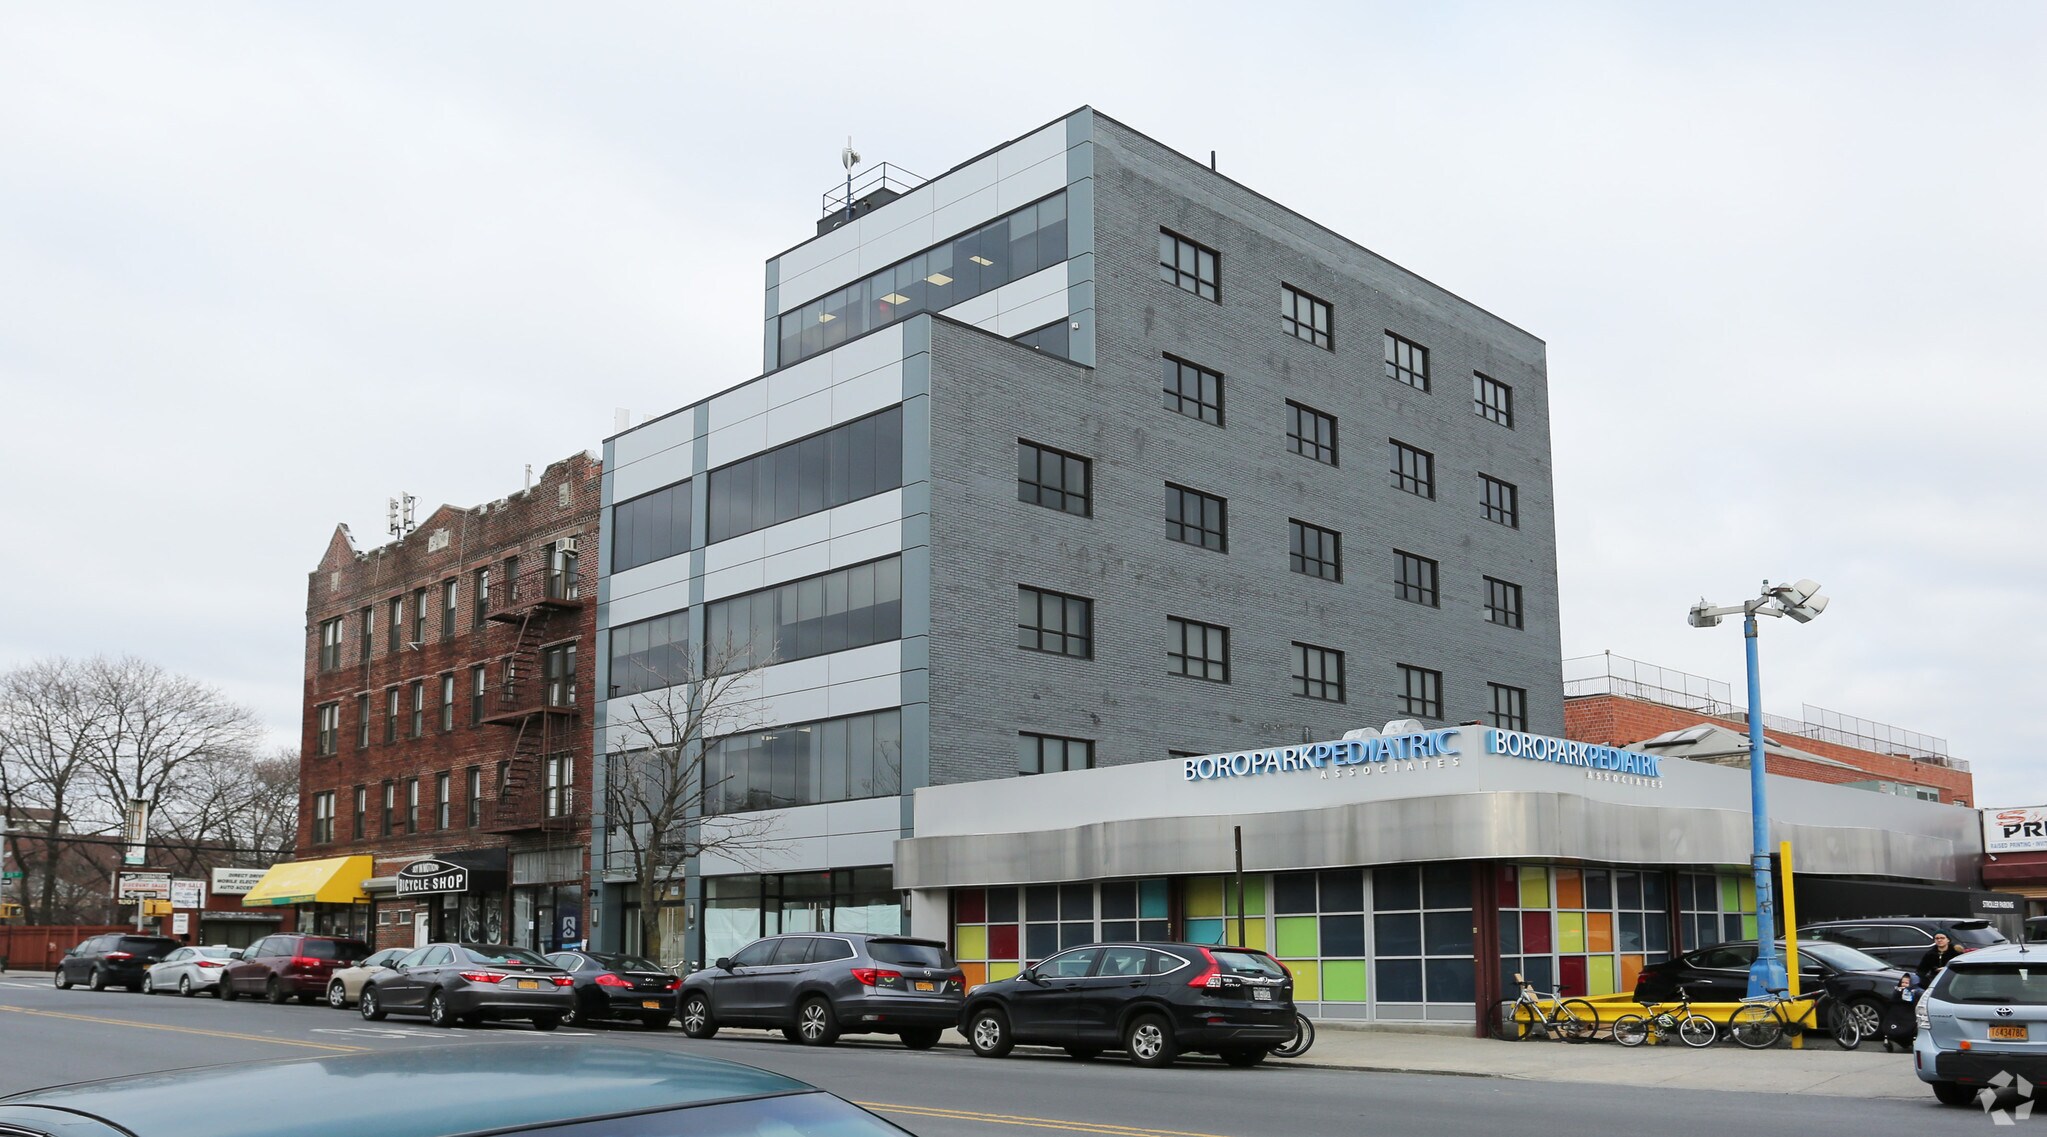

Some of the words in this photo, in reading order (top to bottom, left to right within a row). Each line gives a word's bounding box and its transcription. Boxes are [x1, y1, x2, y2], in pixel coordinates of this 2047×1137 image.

[1319, 757, 1460, 780] ASSOCIATES
[1586, 770, 1663, 789] ASSOCIATES
[399, 878, 429, 892] BICYCLE
[432, 874, 463, 889] SHOP
